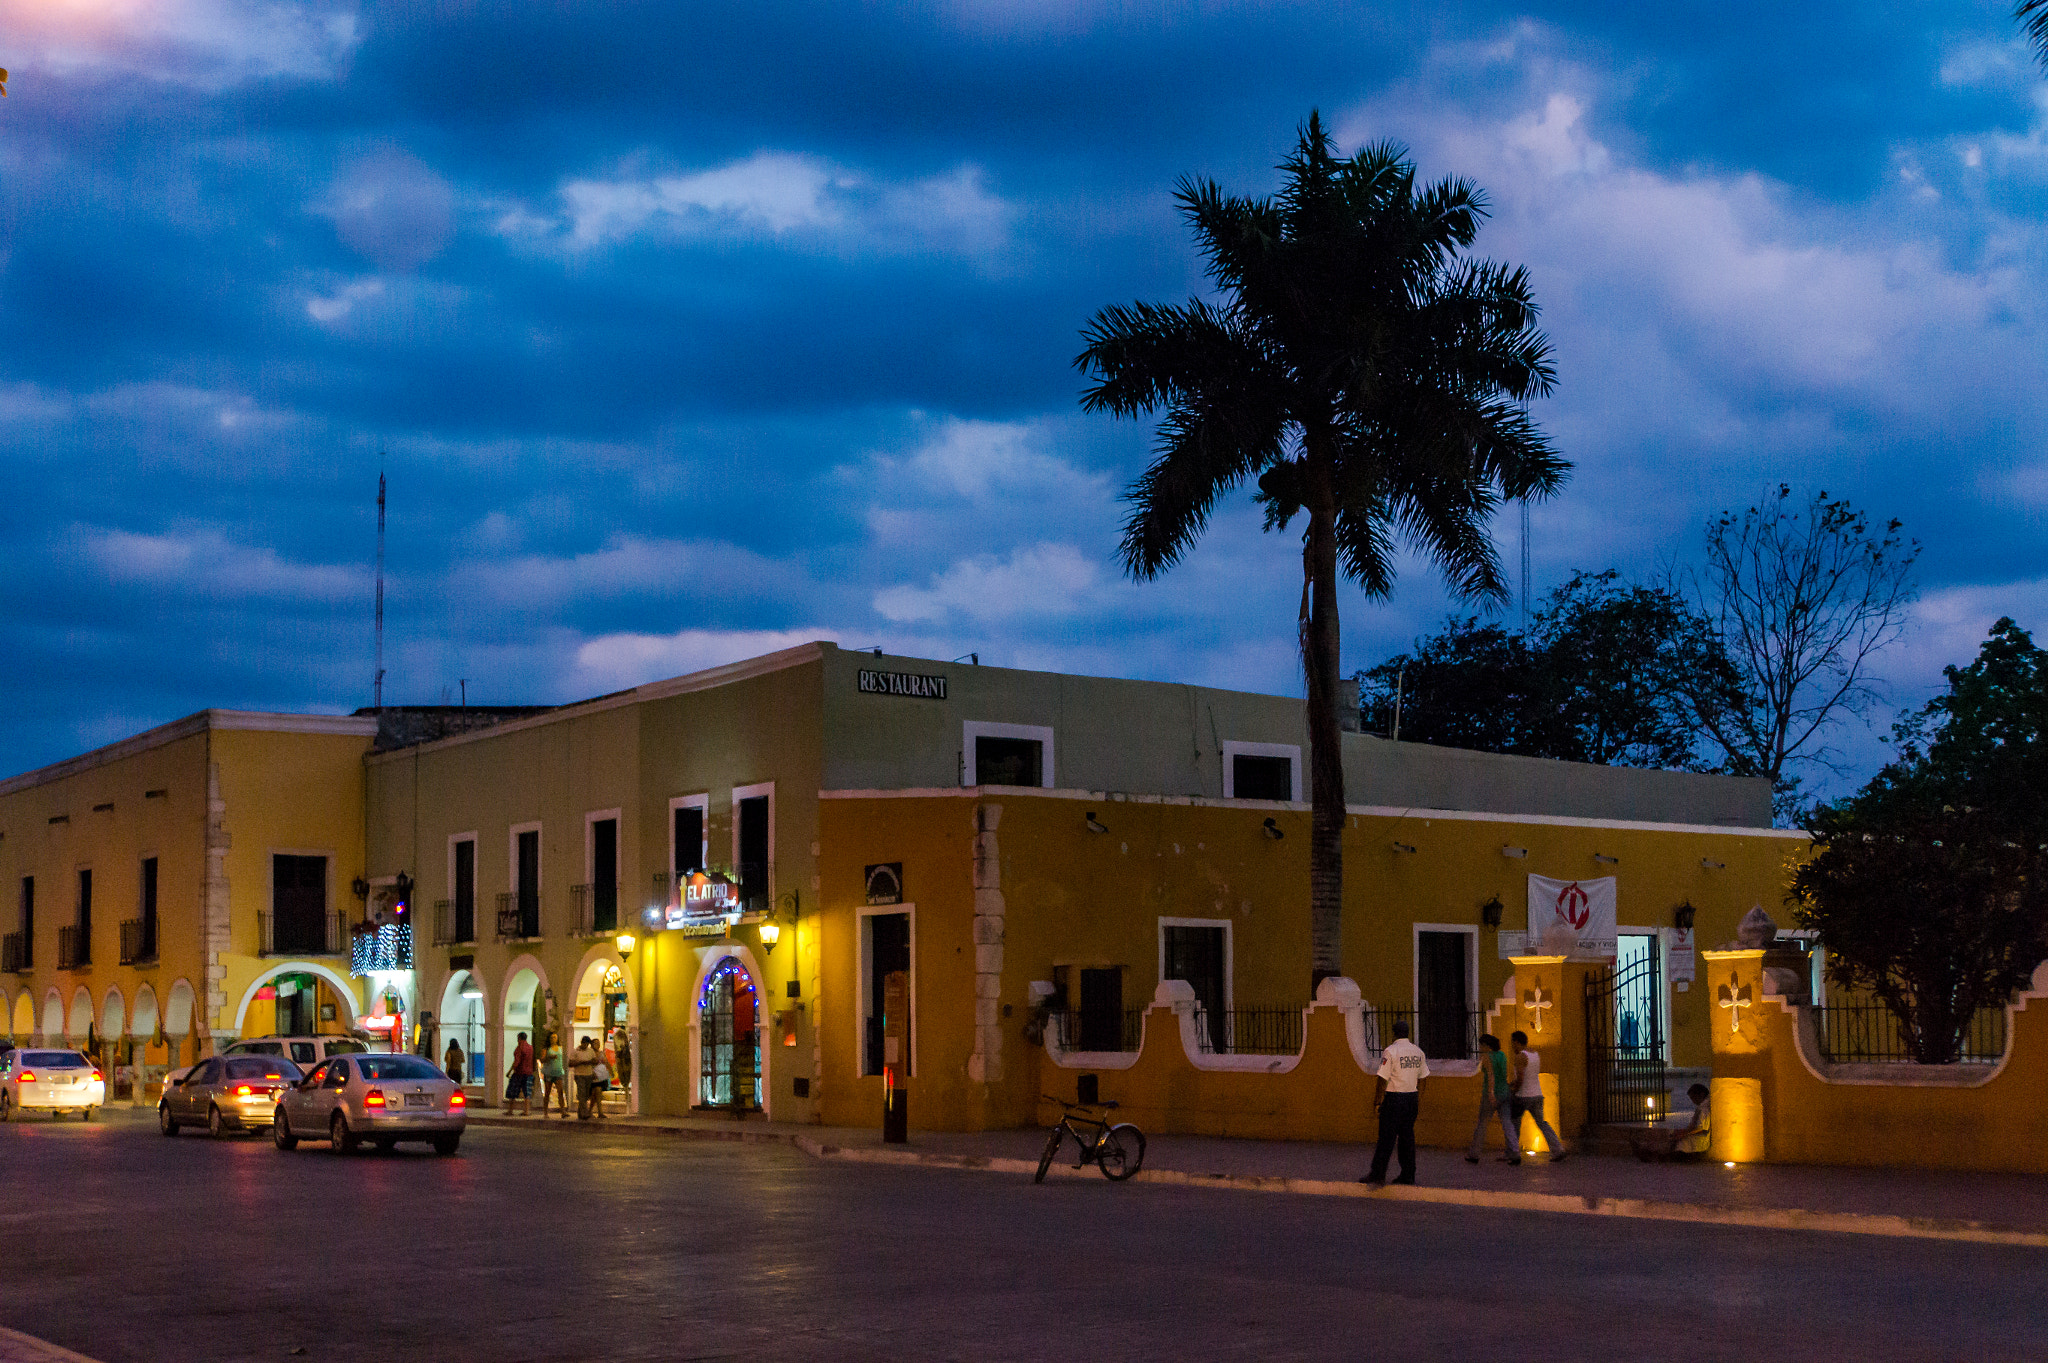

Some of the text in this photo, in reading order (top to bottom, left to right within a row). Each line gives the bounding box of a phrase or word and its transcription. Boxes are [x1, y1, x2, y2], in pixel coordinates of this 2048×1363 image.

[860, 670, 946, 698] RESTAURANT
[687, 884, 727, 901] EL ATRIO
